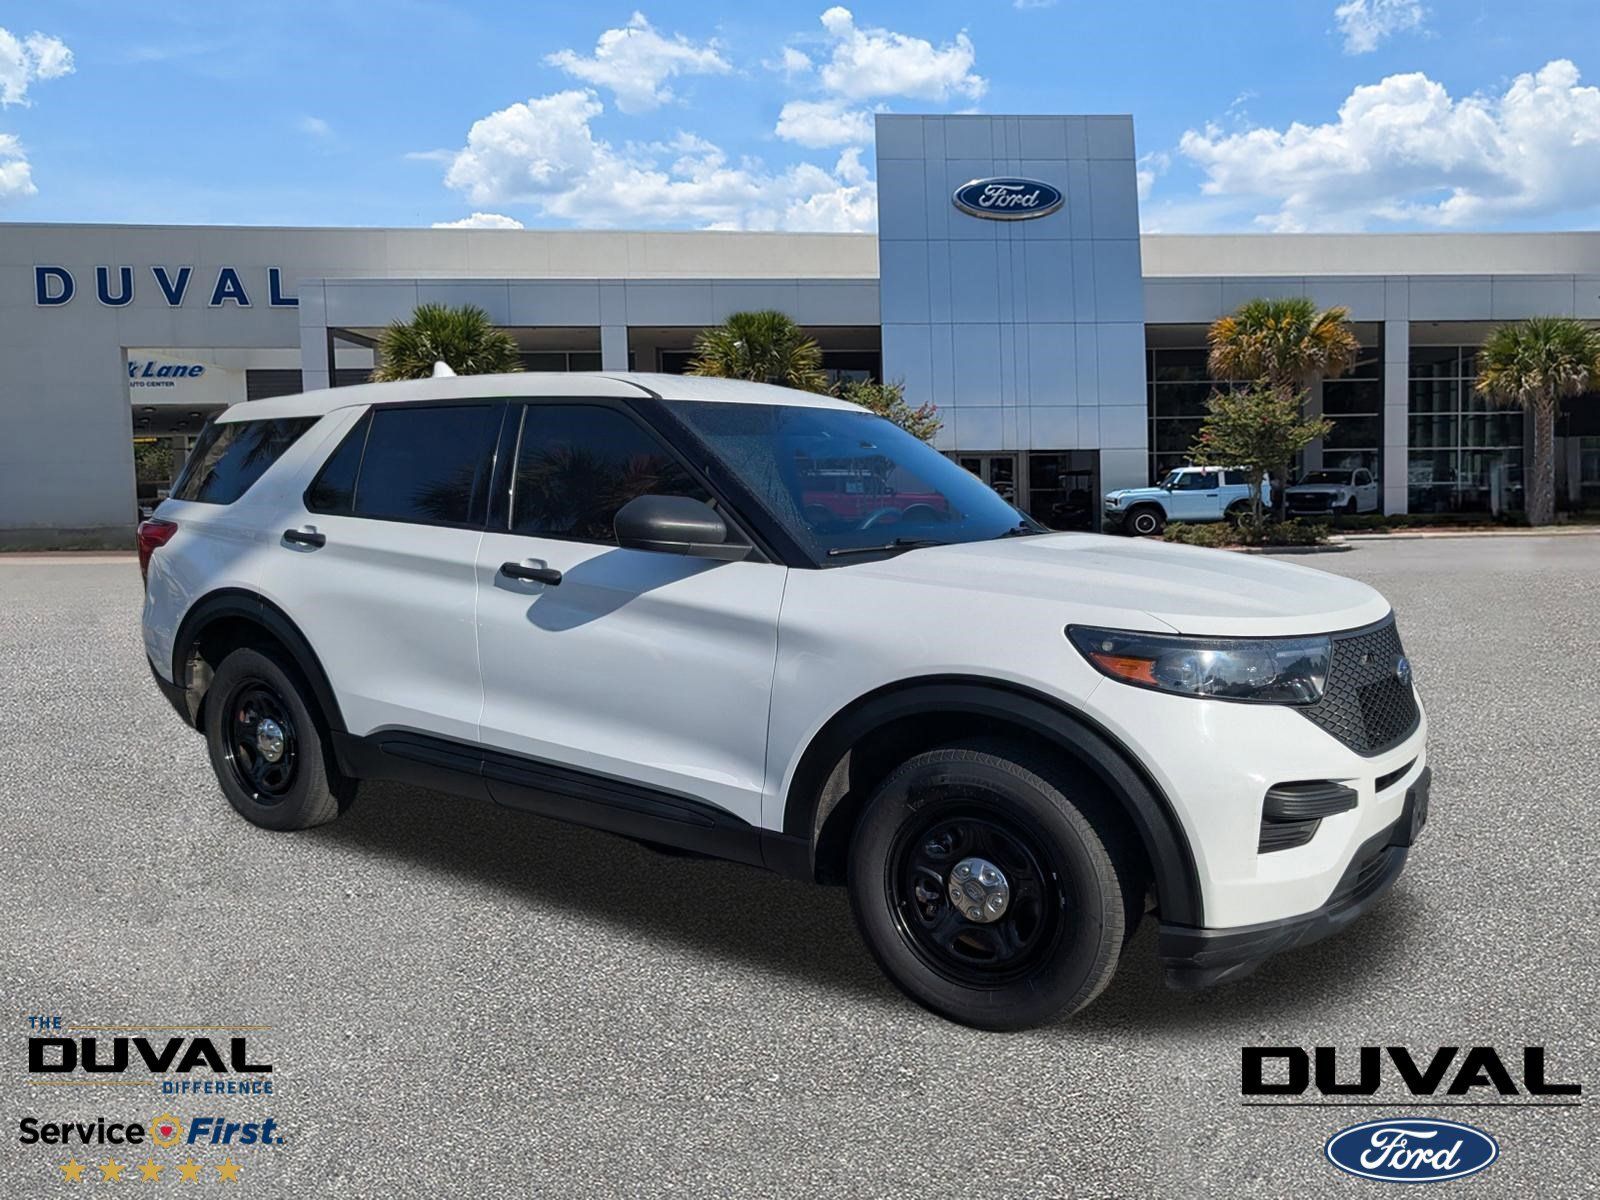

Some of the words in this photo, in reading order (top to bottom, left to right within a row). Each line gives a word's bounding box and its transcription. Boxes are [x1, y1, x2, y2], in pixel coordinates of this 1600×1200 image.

[978, 184, 1040, 207] Ford
[33, 265, 299, 308] DUVAL
[142, 361, 205, 378] Lane
